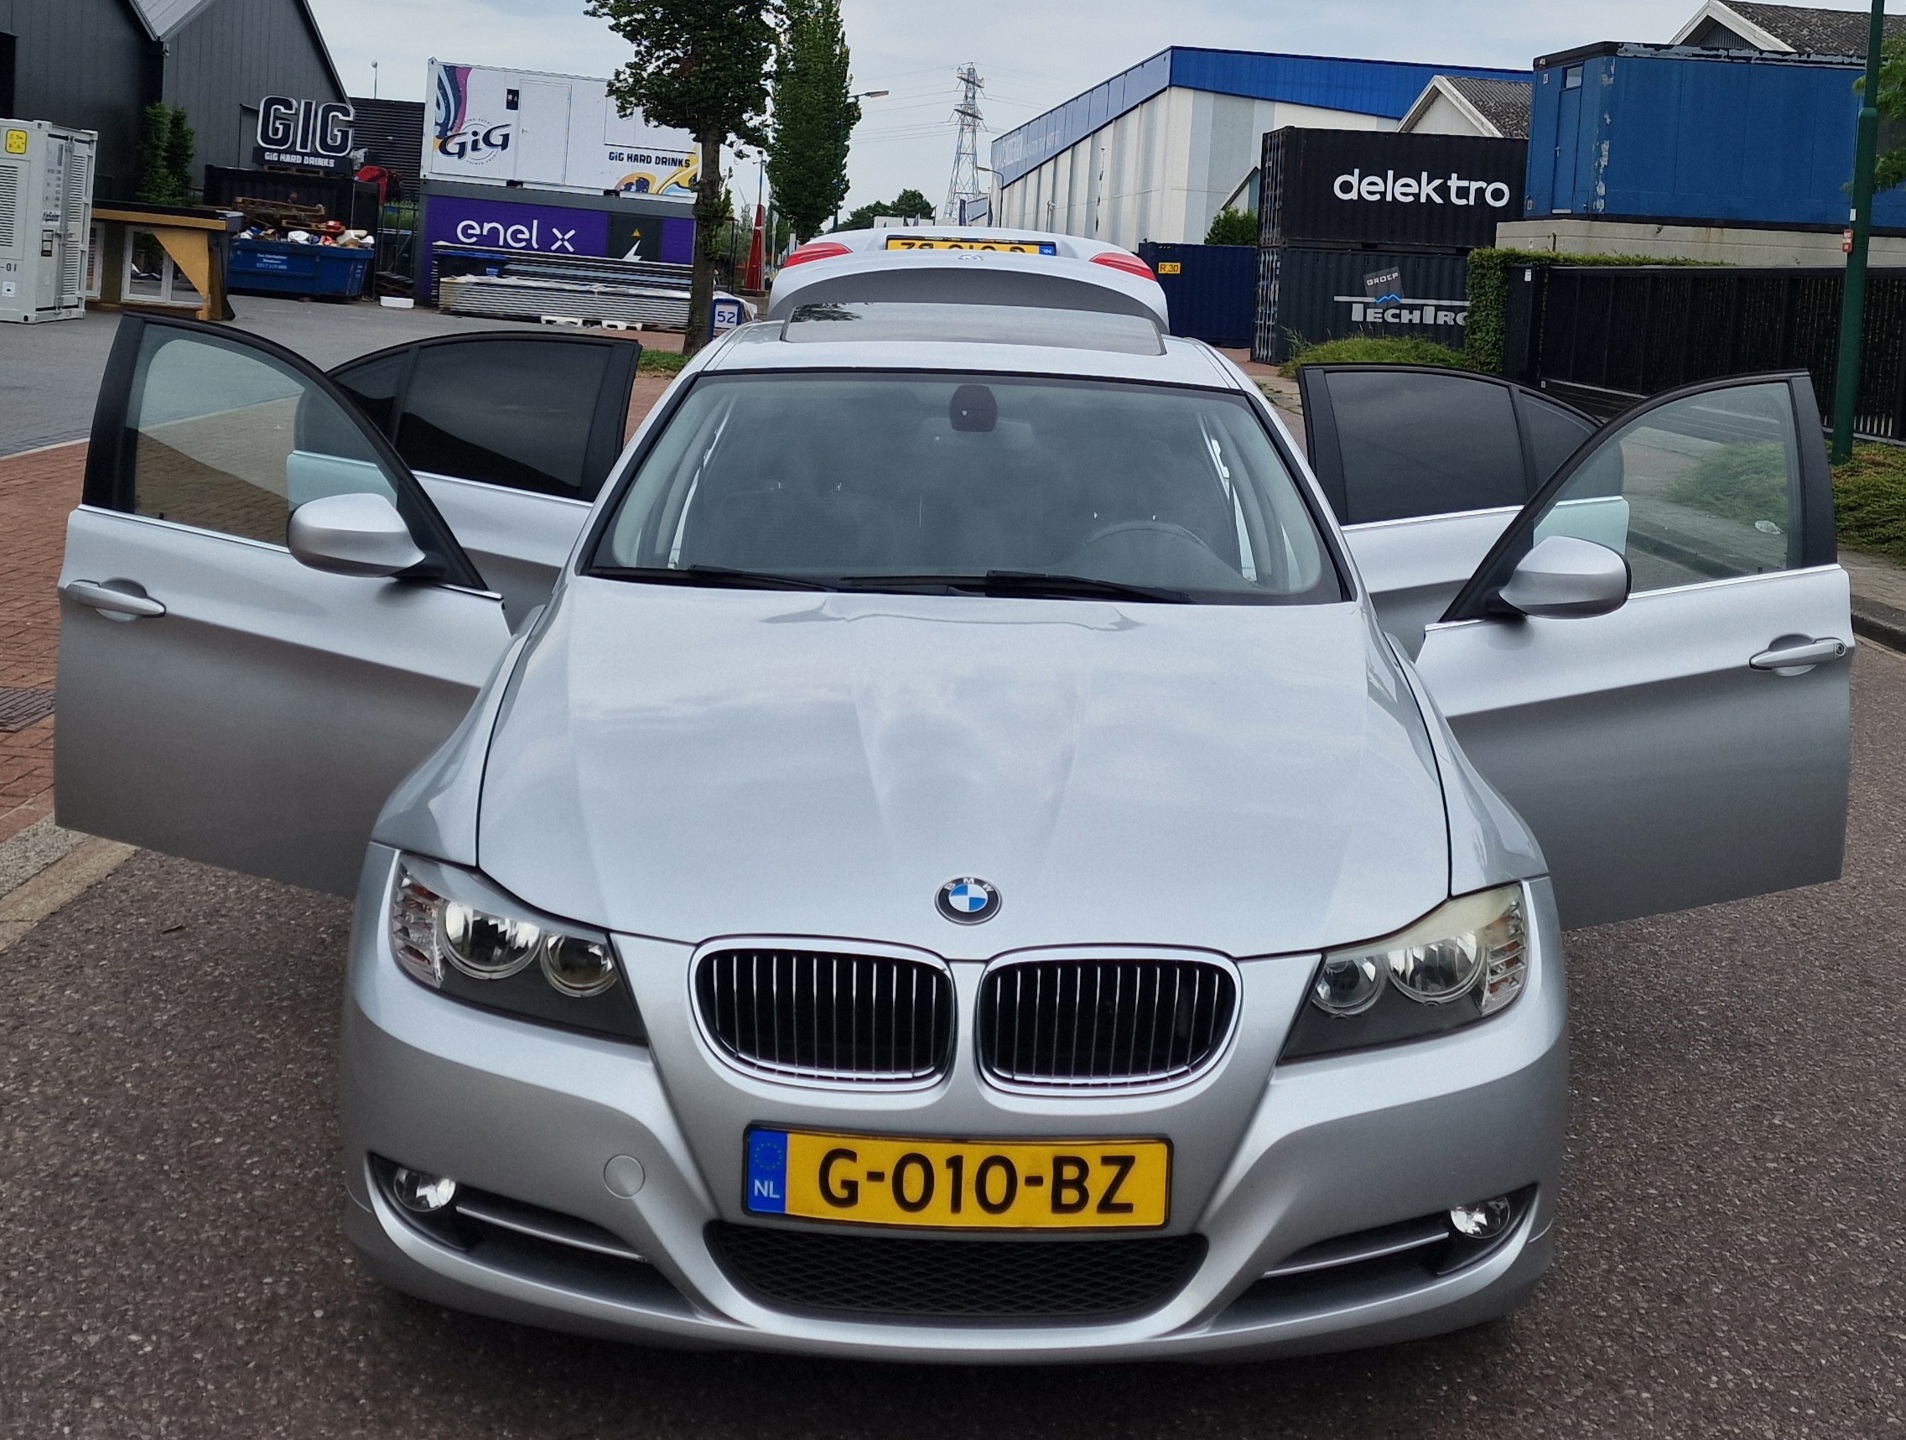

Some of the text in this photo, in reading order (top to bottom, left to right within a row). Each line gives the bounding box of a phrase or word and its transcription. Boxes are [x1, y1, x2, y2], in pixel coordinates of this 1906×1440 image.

[257, 96, 355, 156] GIG
[280, 153, 302, 164] HARD
[303, 156, 335, 168] DRINKS
[626, 153, 653, 165] HARD
[654, 156, 691, 168] DRINKS
[1333, 168, 1510, 208] delektro
[456, 219, 539, 249] enel
[717, 310, 736, 324] 52
[943, 877, 994, 892] BMW
[753, 1148, 1136, 1216] NL G-010-BZ
